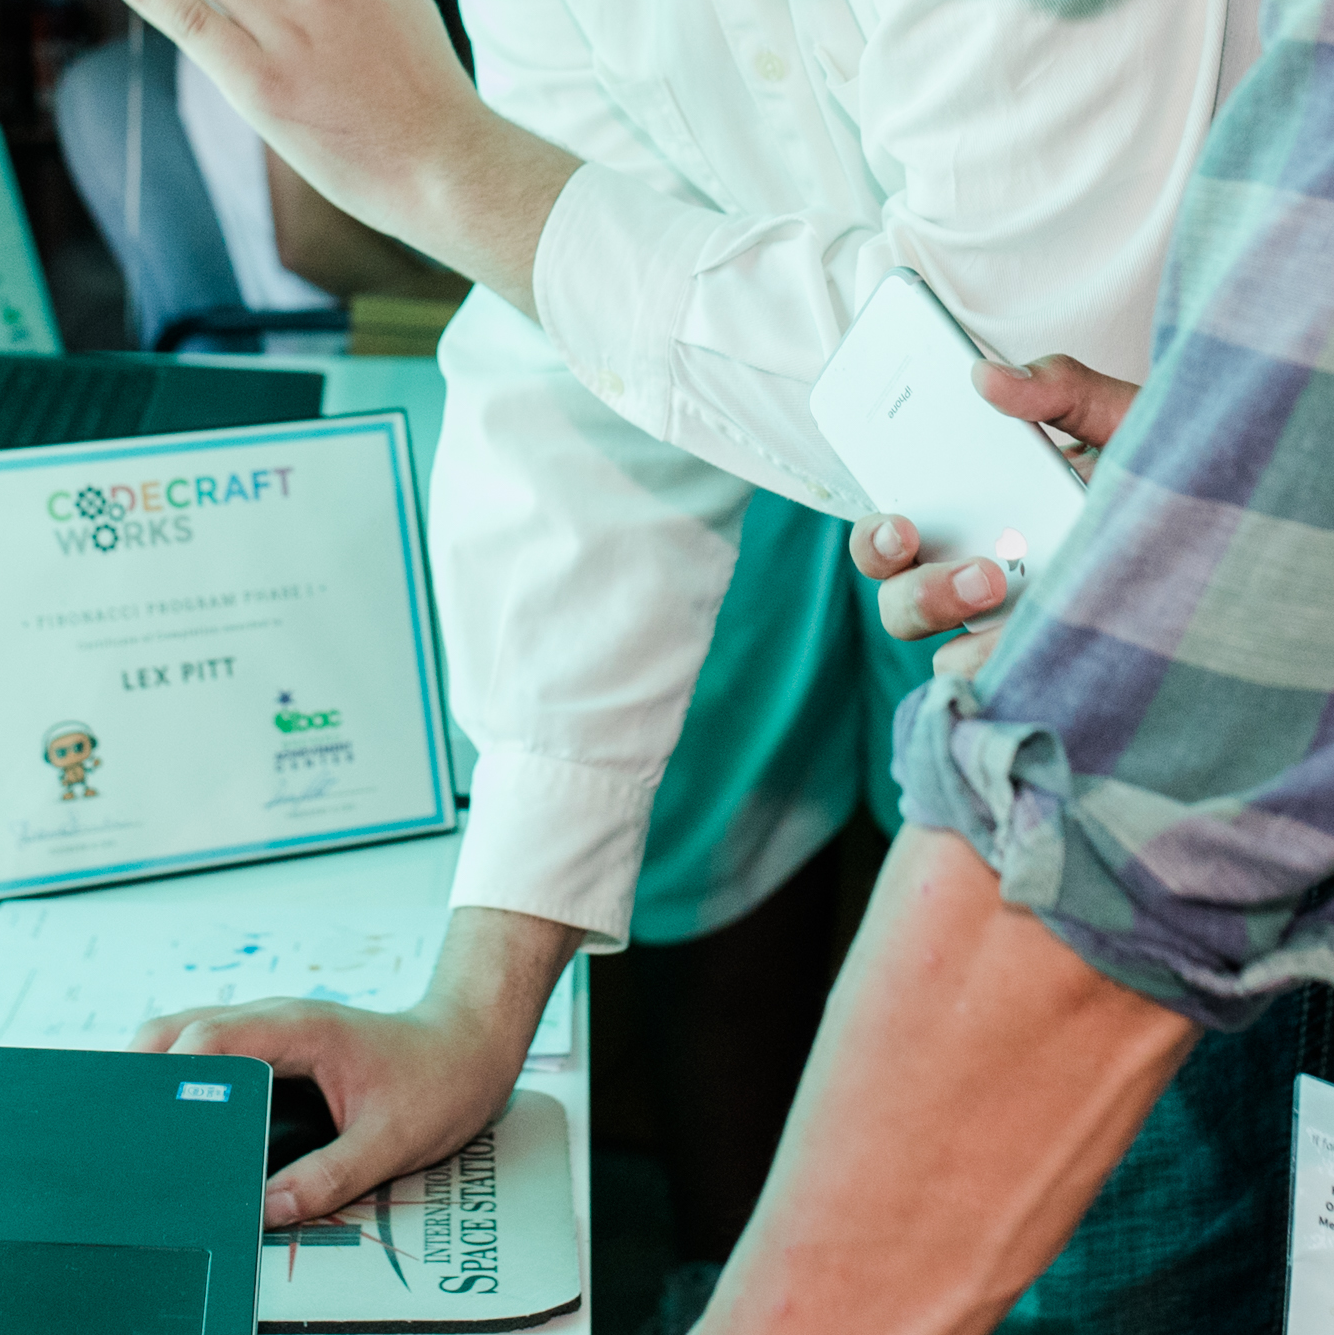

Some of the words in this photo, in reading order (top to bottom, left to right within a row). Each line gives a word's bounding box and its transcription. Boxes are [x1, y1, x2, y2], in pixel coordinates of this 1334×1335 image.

[887, 384, 912, 420] iPhone
[47, 466, 293, 522] CODECRAFT
[53, 516, 193, 556] WORKS
[122, 665, 170, 691] LEX
[181, 656, 235, 683] PITT
[439, 1218, 499, 1295] SPACE
